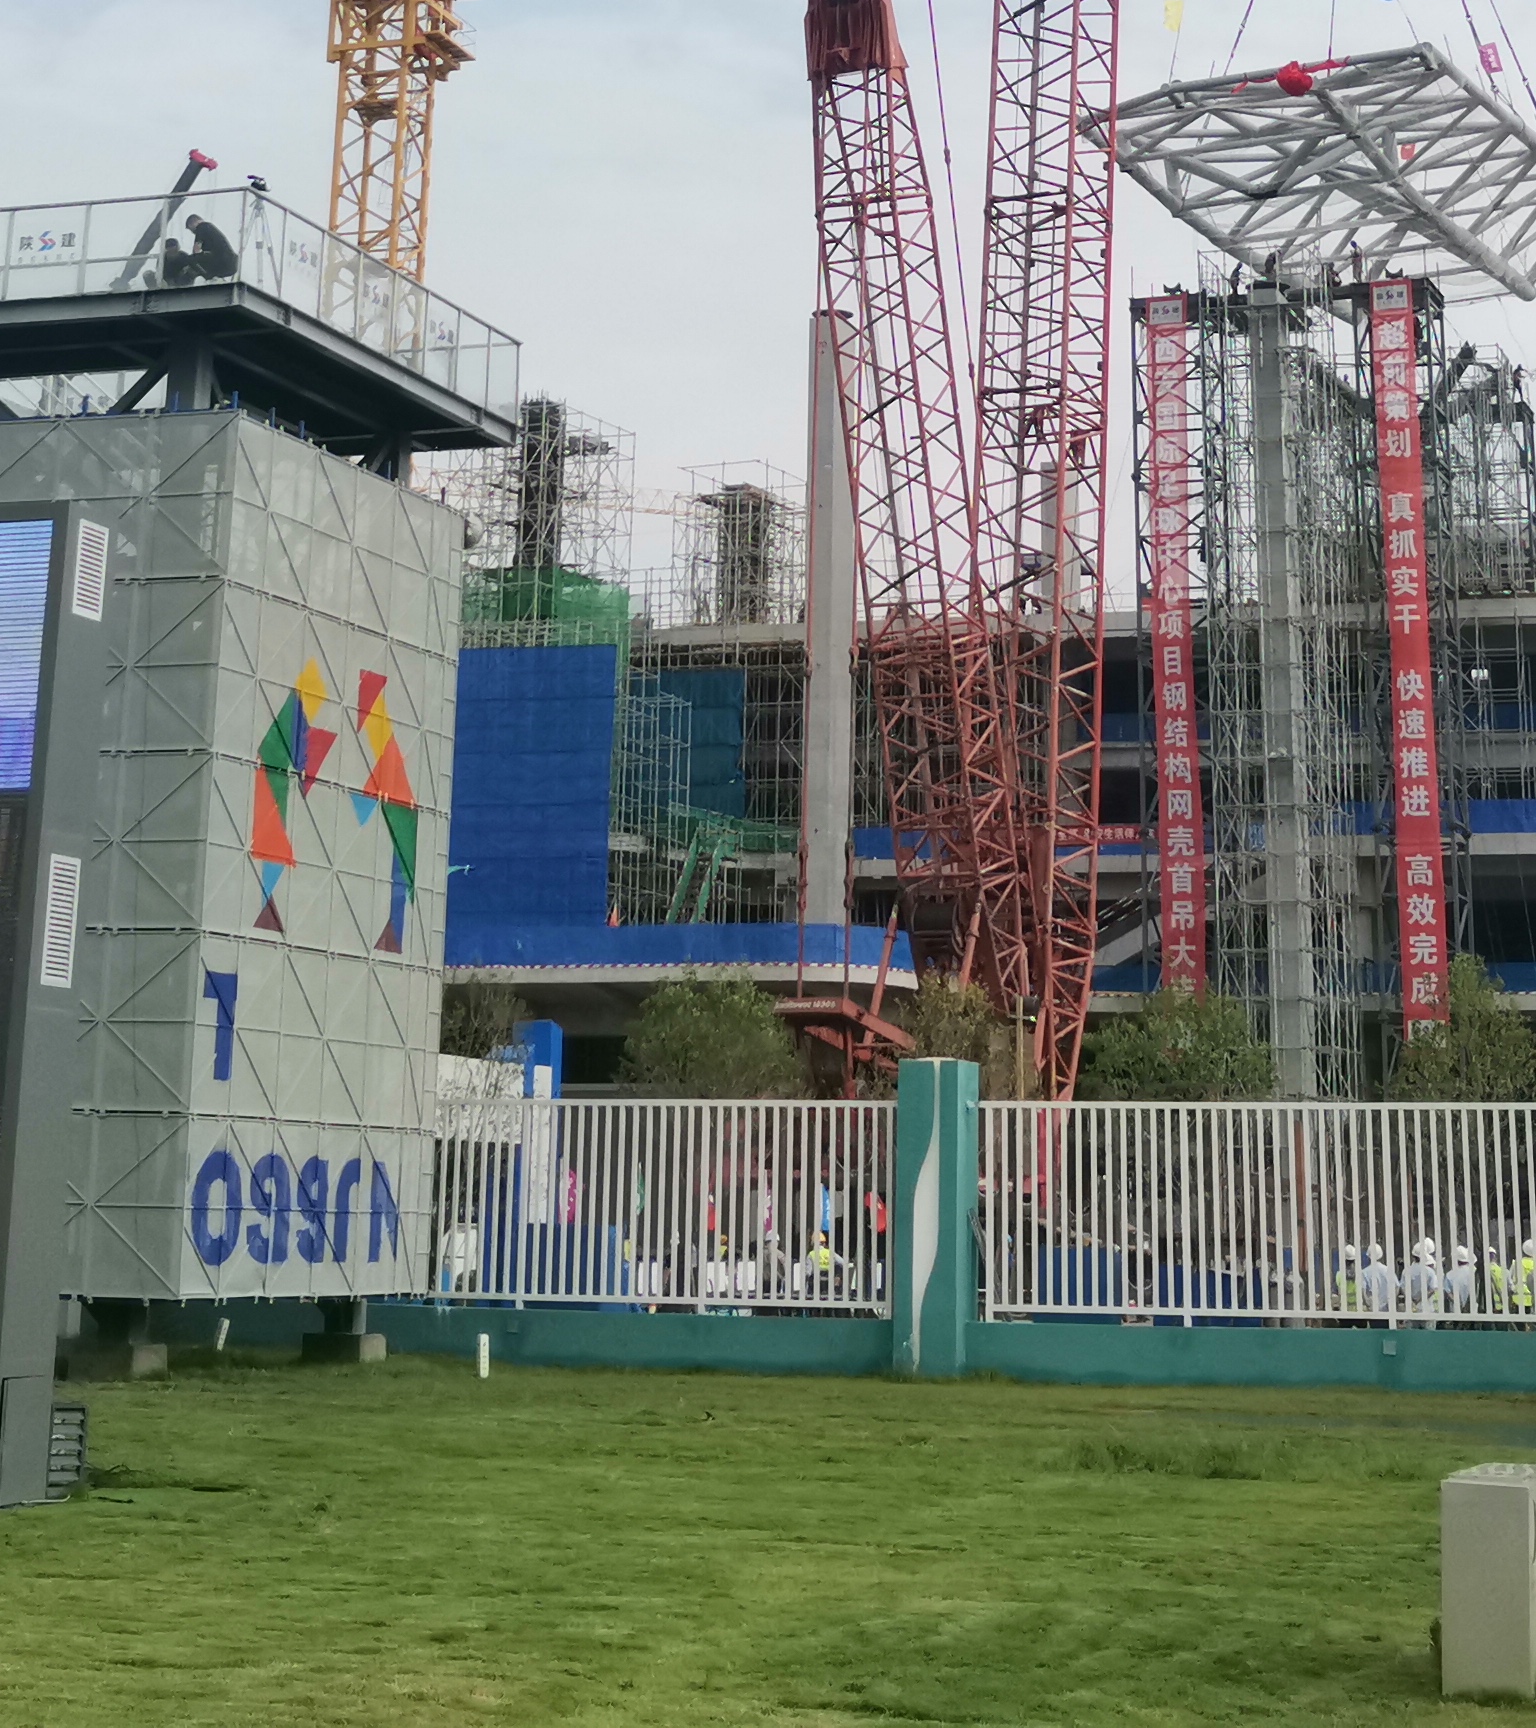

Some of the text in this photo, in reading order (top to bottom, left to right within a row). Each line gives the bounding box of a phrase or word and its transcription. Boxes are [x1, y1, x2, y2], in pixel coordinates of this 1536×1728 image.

[1377, 320, 1413, 459] 超前策划
[1386, 491, 1421, 635] 真抓实干
[1396, 668, 1431, 818] 快速推进
[1404, 853, 1440, 1005] 高效完成
